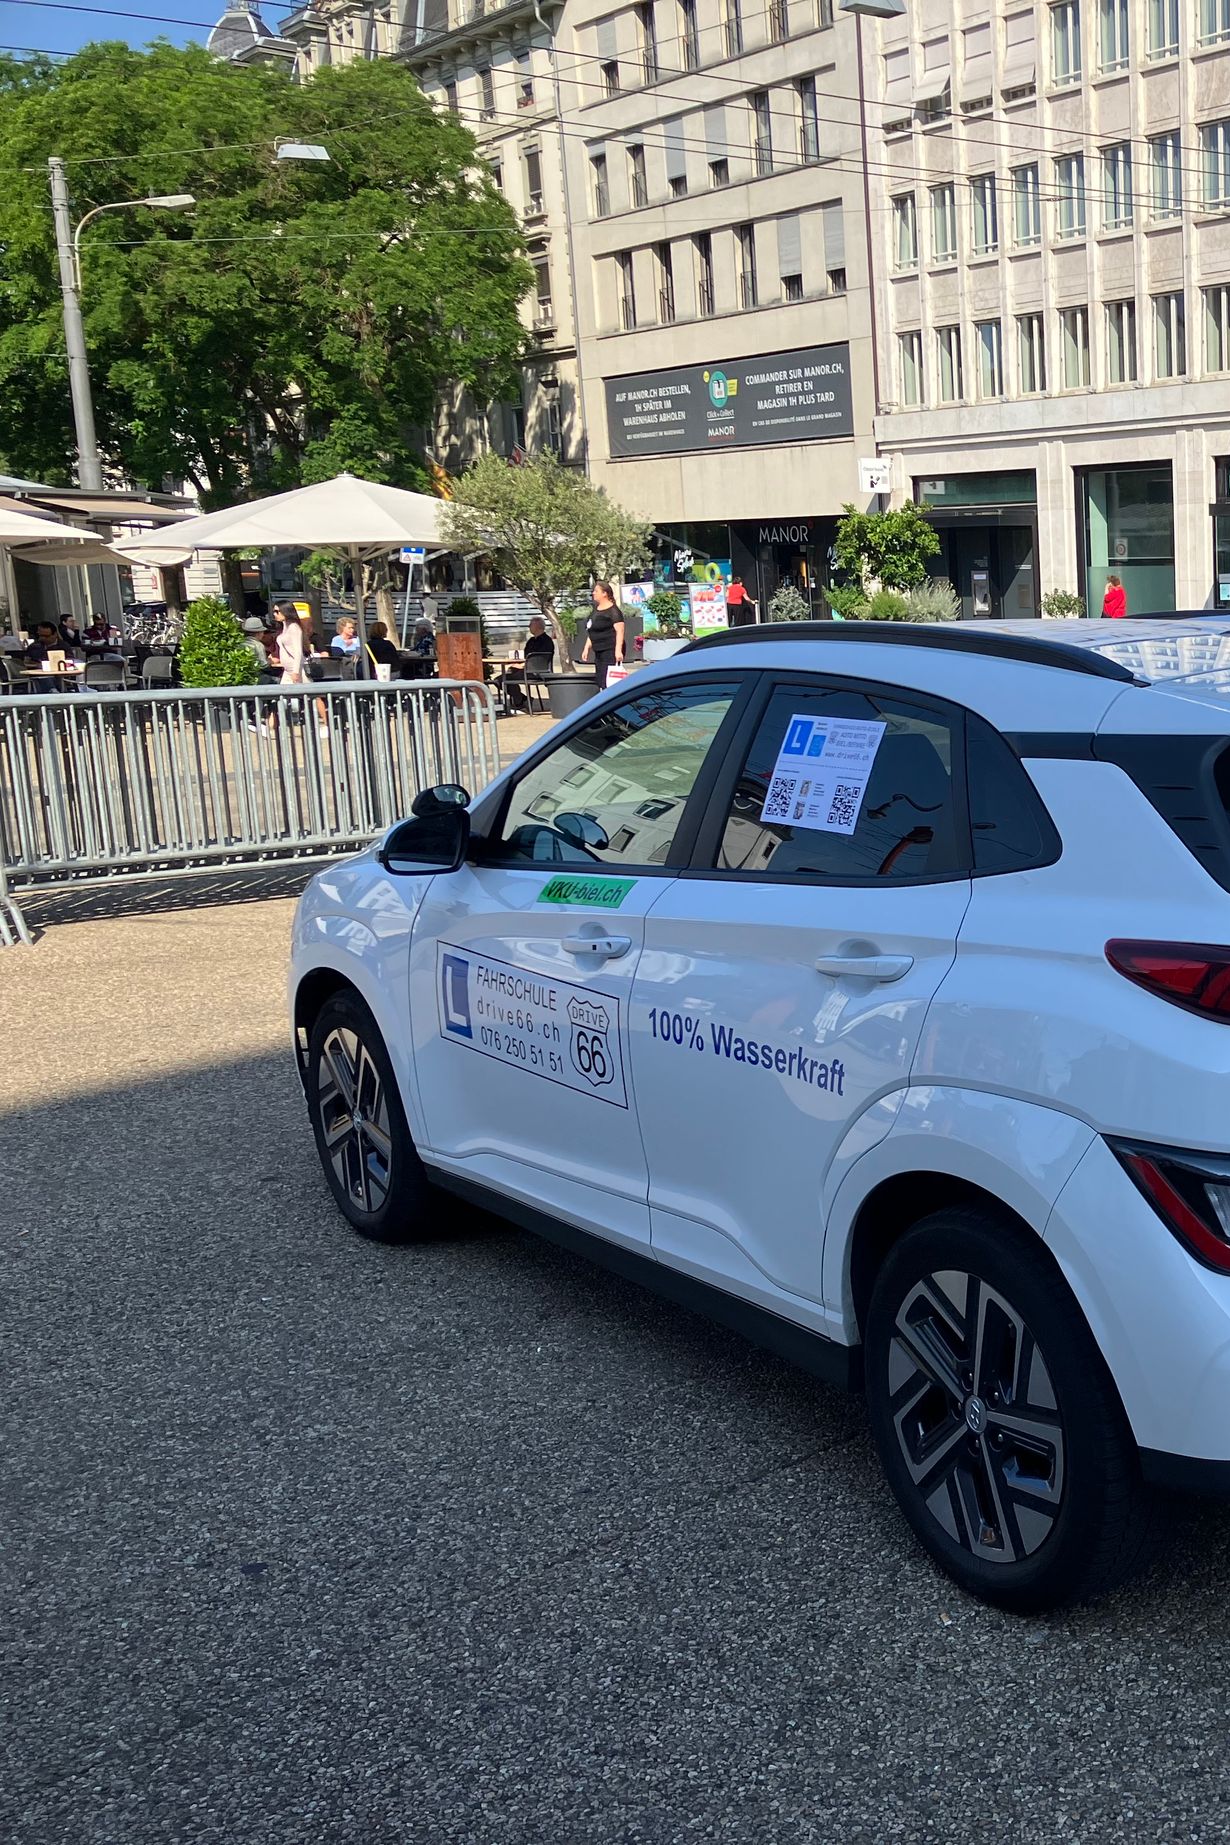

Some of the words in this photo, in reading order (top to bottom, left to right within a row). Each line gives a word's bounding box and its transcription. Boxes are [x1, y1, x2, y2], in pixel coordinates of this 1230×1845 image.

[745, 370, 788, 386] COMMANDER
[788, 369, 803, 379] SUR
[804, 363, 844, 377] MANOR.CH,
[615, 393, 627, 402] AUF
[627, 388, 658, 401] MANOR.CH
[658, 384, 691, 397] BESTELLEN,
[775, 384, 803, 395] RETIRER
[803, 381, 813, 391] EN
[634, 403, 642, 413] 1H
[642, 399, 663, 412] SPÄTER
[664, 400, 672, 409] IM
[757, 397, 788, 410] MAGASIN
[788, 396, 797, 406] 1H
[798, 394, 816, 405] PLUS
[816, 391, 835, 403] TARD
[623, 414, 658, 426] WARENHAUS
[658, 410, 686, 423] ABHOLEN
[708, 425, 735, 437] MANOR
[759, 525, 809, 543] MANOR
[546, 879, 623, 902] VKU-biel.ch
[445, 965, 467, 1027] L
[477, 966, 557, 1011] FAHRSCHULE
[477, 997, 560, 1043] drive66.ch
[571, 1005, 605, 1029] DRIVE
[480, 1026, 501, 1051] 076
[506, 1035, 526, 1061] 250
[531, 1044, 544, 1067] 51
[550, 1052, 564, 1075] 51
[576, 1030, 606, 1078] 66
[649, 1008, 704, 1051] 100%
[710, 1022, 845, 1097] Wasserkraft
